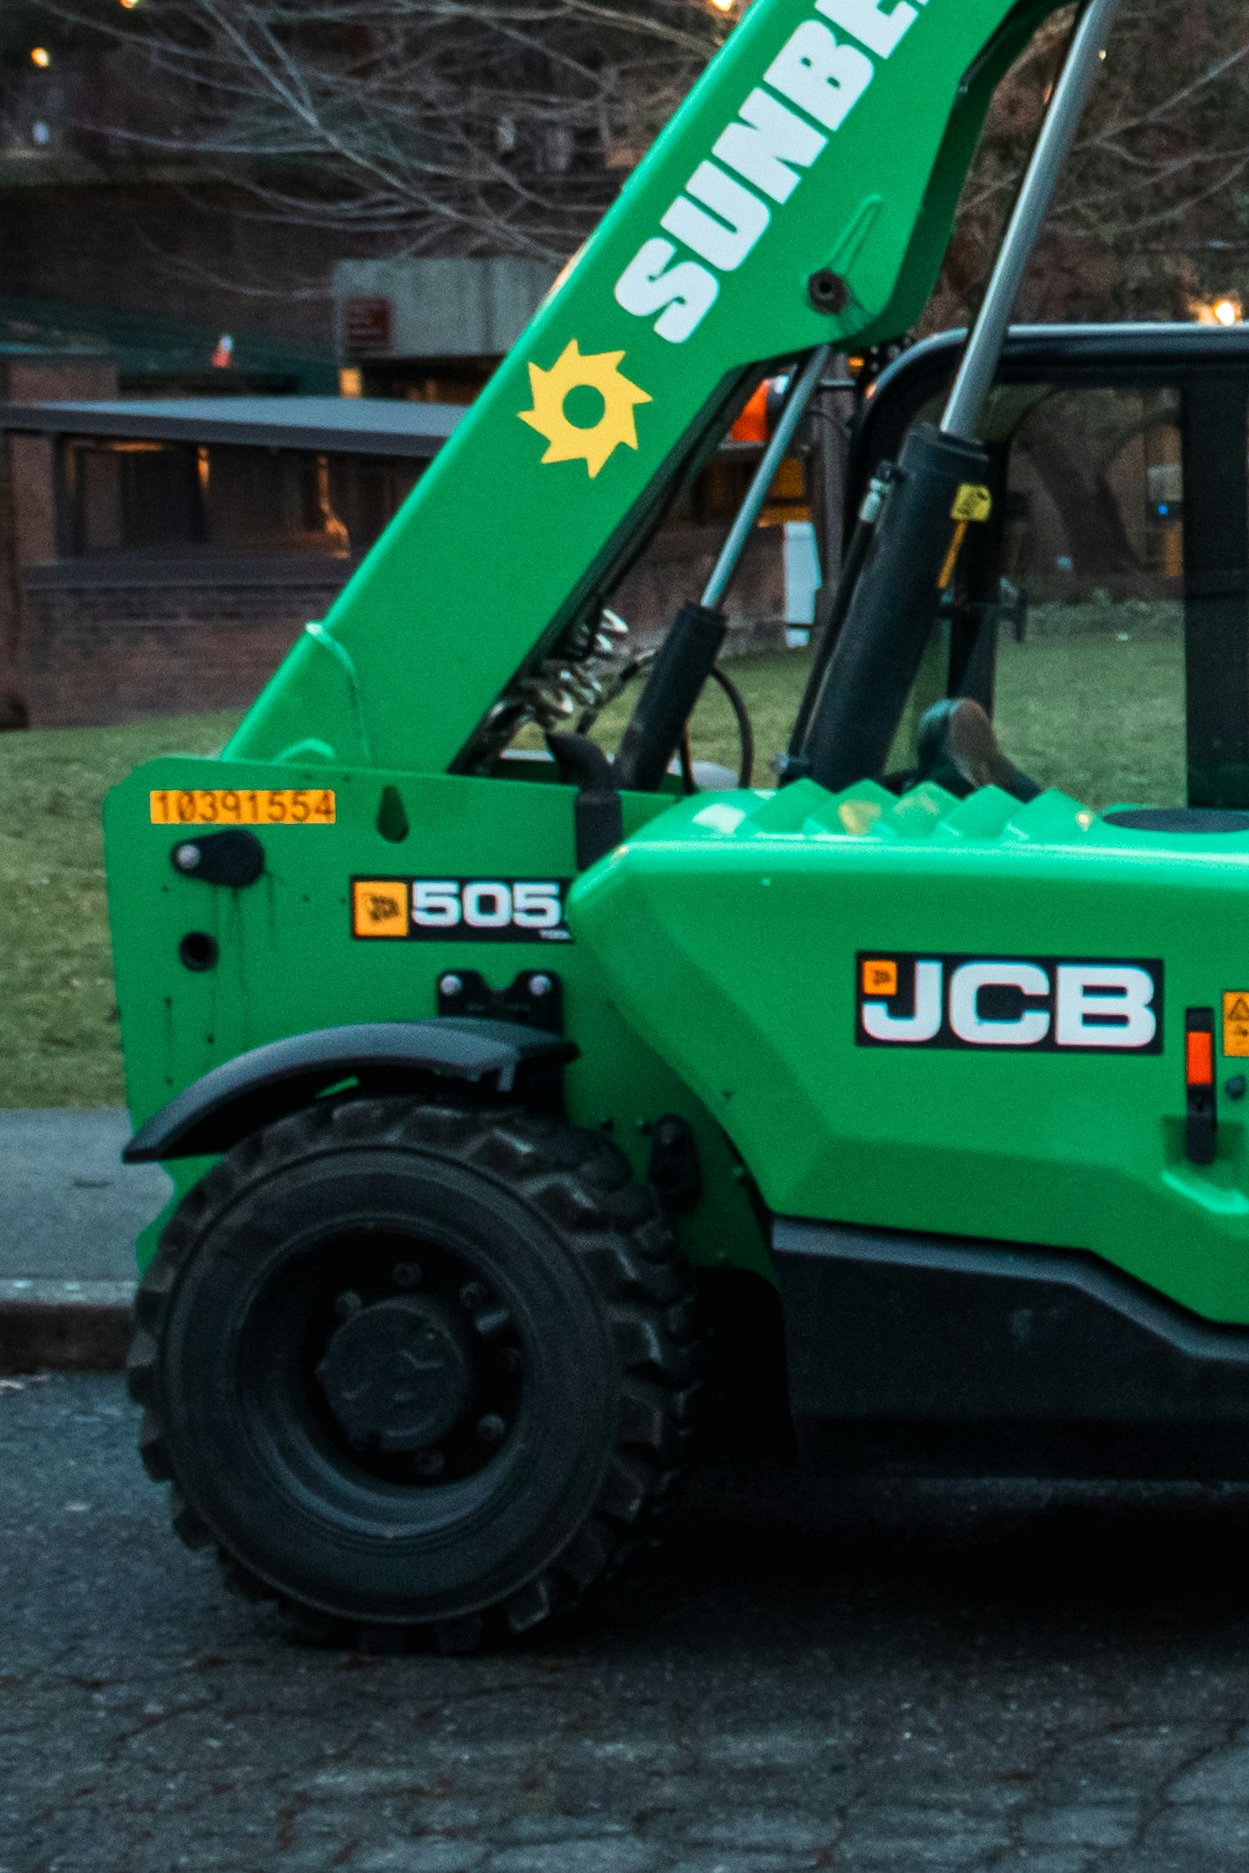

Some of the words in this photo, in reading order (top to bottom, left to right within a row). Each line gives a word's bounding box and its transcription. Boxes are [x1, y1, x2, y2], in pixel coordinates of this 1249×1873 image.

[156, 791, 335, 822] 10391554
[412, 880, 562, 928] 505
[862, 959, 1157, 1048] JCB
